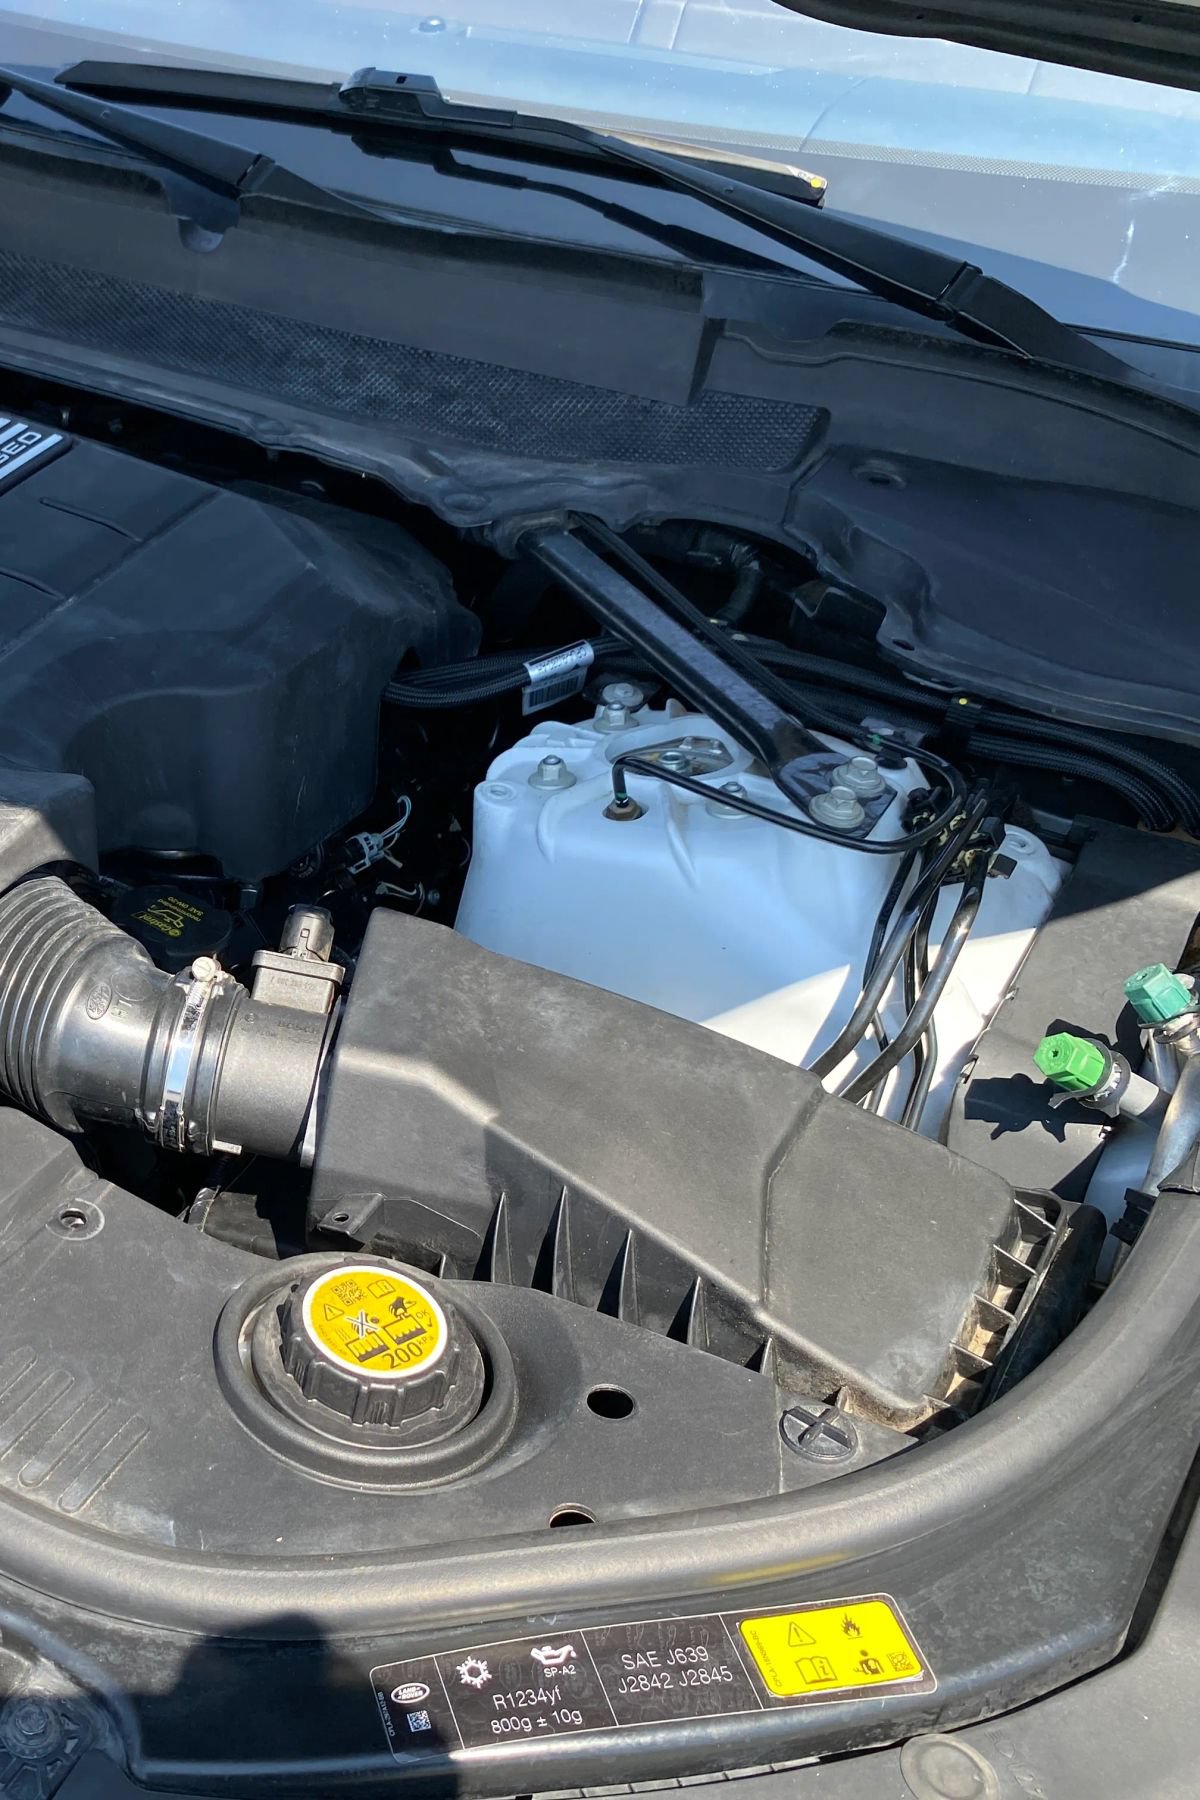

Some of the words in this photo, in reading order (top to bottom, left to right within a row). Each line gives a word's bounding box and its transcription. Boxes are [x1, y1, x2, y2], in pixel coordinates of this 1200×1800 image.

[416, 1309, 430, 1319] OK
[382, 1342, 423, 1369] 200
[419, 1336, 434, 1346] kPa
[622, 1650, 661, 1670] SAE
[667, 1645, 710, 1668] J639
[543, 1664, 576, 1677] SP-A2
[618, 1673, 673, 1695] J2842
[678, 1665, 734, 1689] J2845
[399, 1686, 416, 1695] LAND
[401, 1690, 423, 1700] ROVER
[493, 1686, 563, 1711] R1234yf
[490, 1715, 533, 1735] 800g
[551, 1707, 584, 1728] 10g
